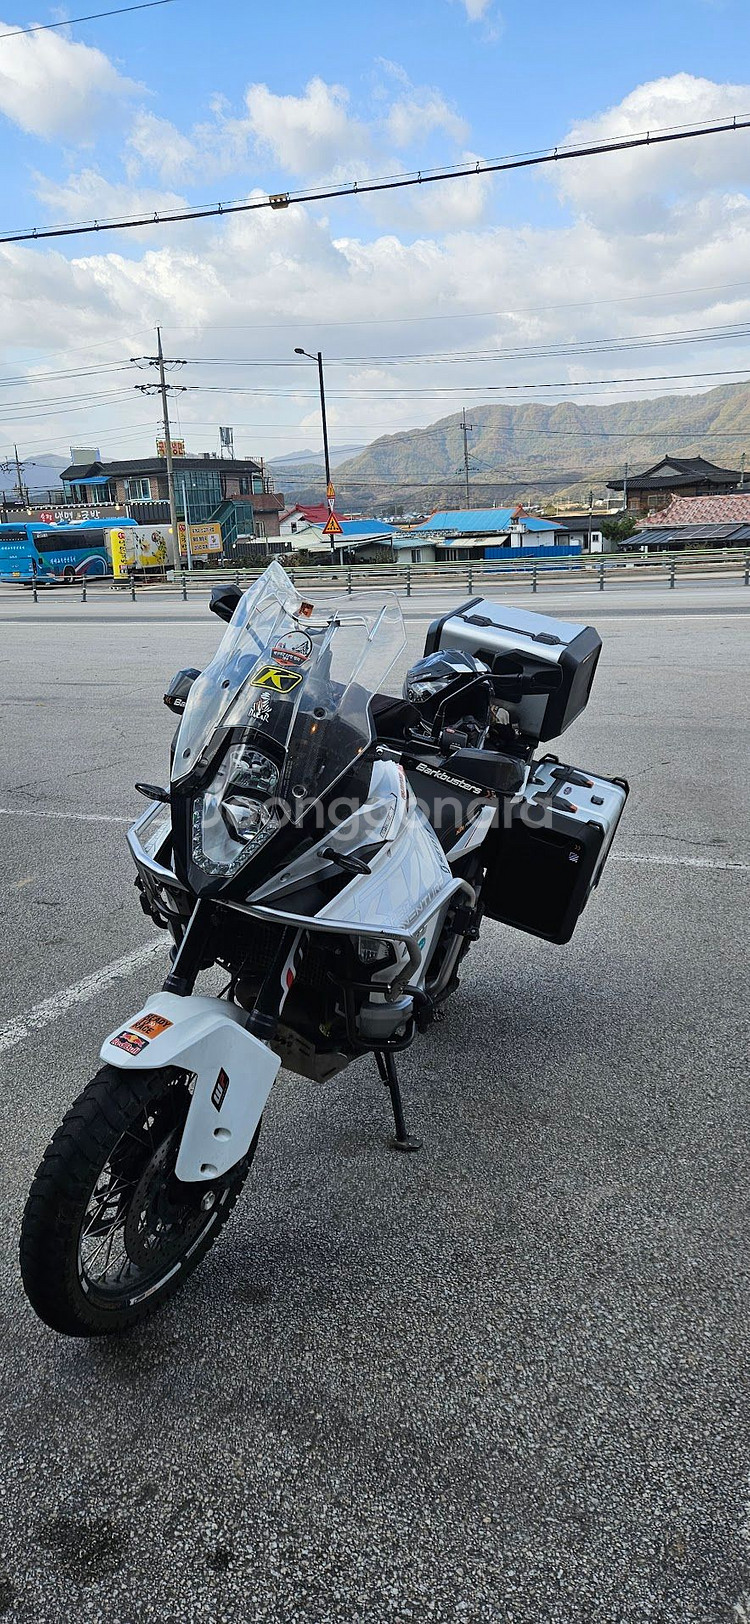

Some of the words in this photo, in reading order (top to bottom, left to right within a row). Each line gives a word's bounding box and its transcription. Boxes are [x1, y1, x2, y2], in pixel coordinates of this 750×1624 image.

[415, 762, 483, 796] Barkbusters
[132, 1021, 154, 1035] RACE
[143, 1012, 170, 1028] READY
